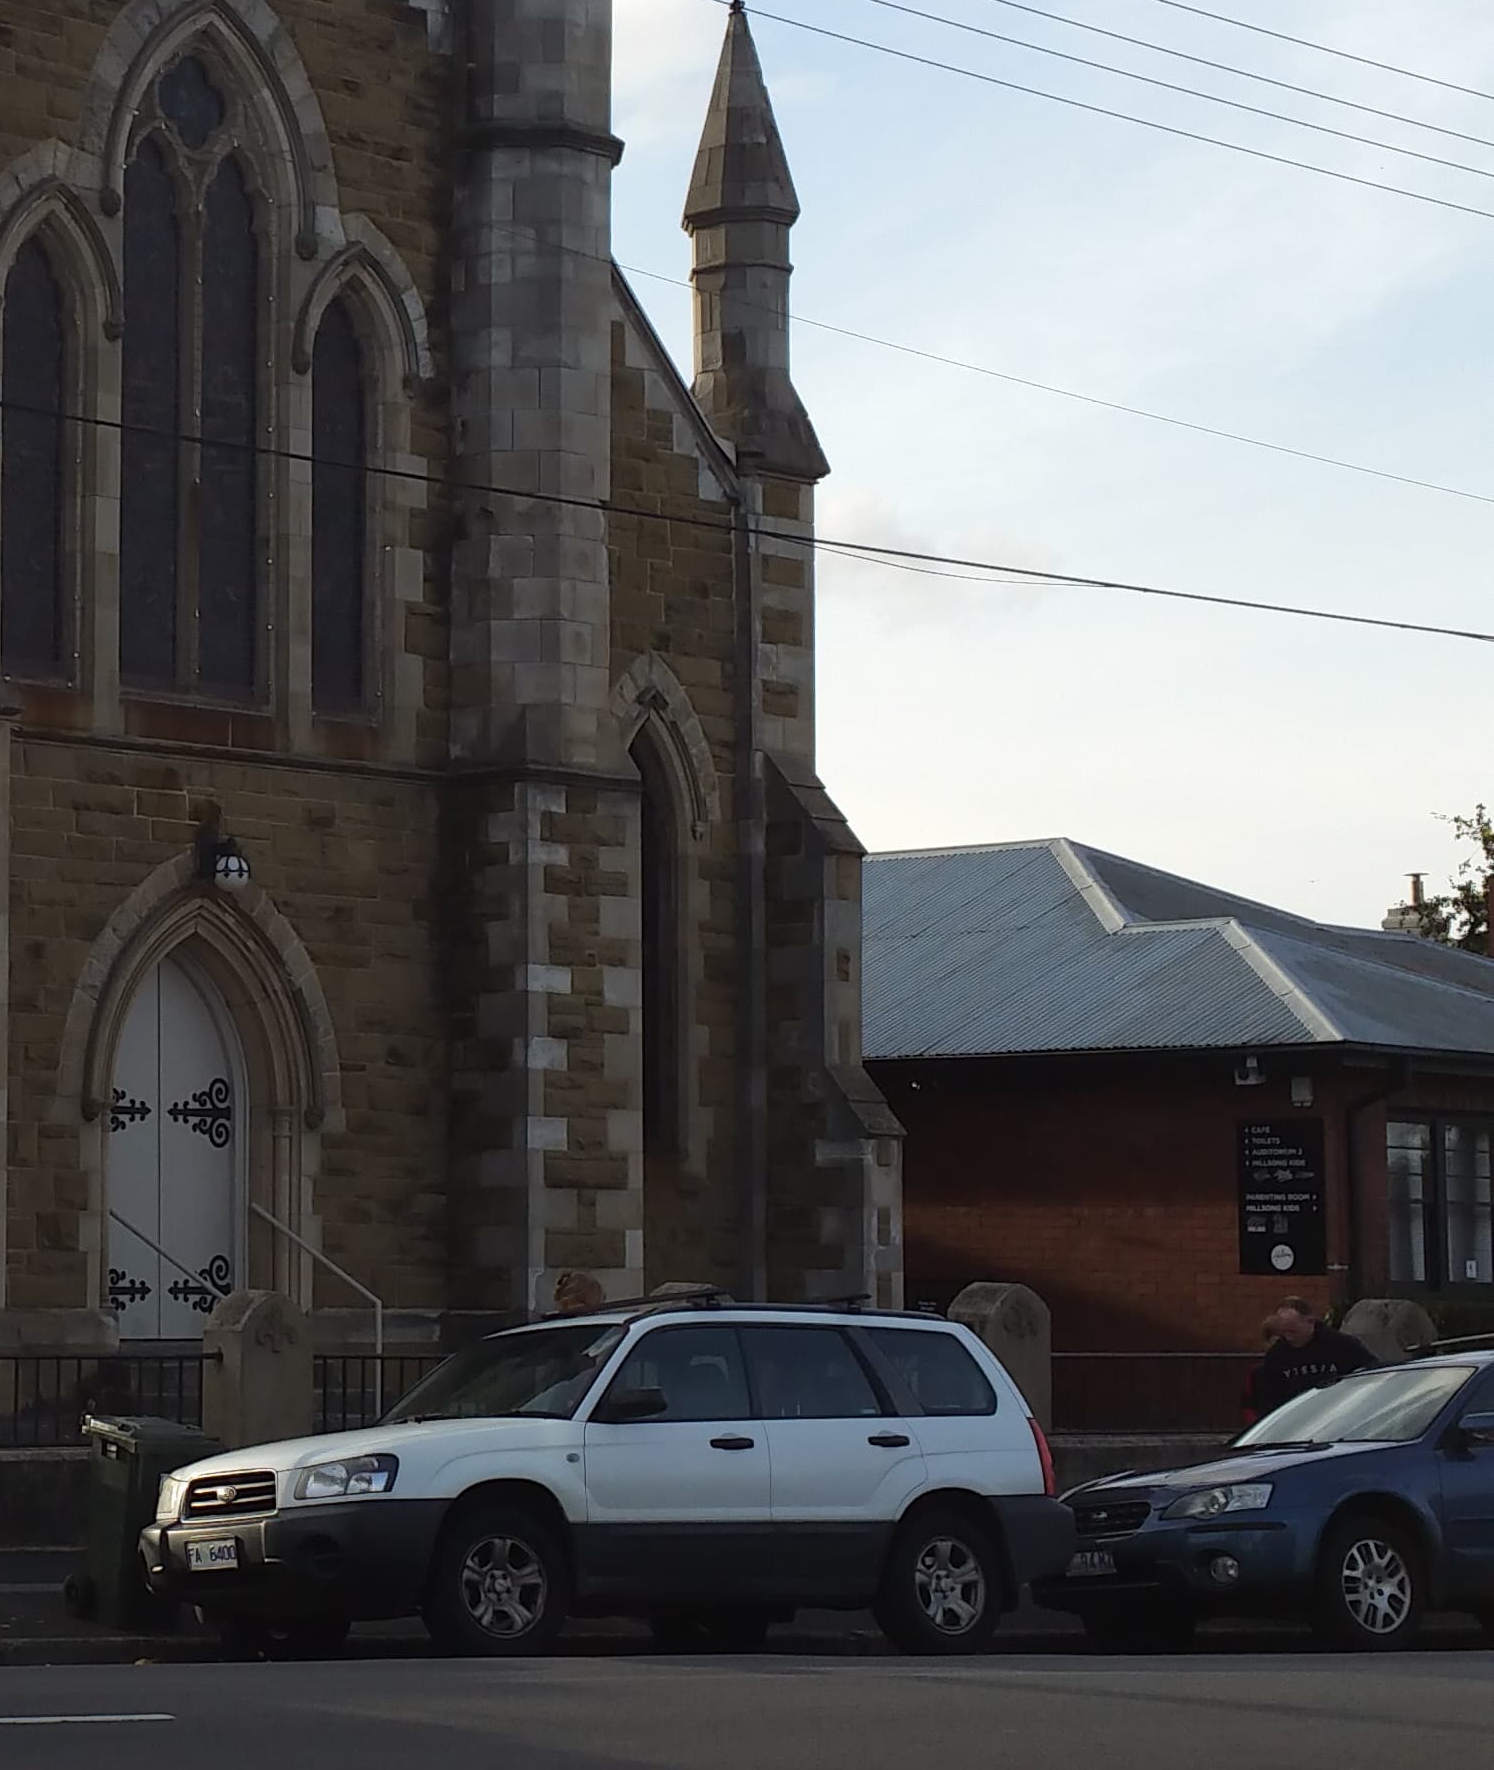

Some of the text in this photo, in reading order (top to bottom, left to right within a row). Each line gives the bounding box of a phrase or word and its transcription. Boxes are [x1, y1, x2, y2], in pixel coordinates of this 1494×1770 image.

[1252, 1137, 1281, 1145] TOILETS
[1252, 1148, 1297, 1156] AUDITORIUM
[1252, 1159, 1288, 1167] HILLSONG
[1246, 1193, 1310, 1201] PARENTING ROOM
[187, 1547, 203, 1564] FA
